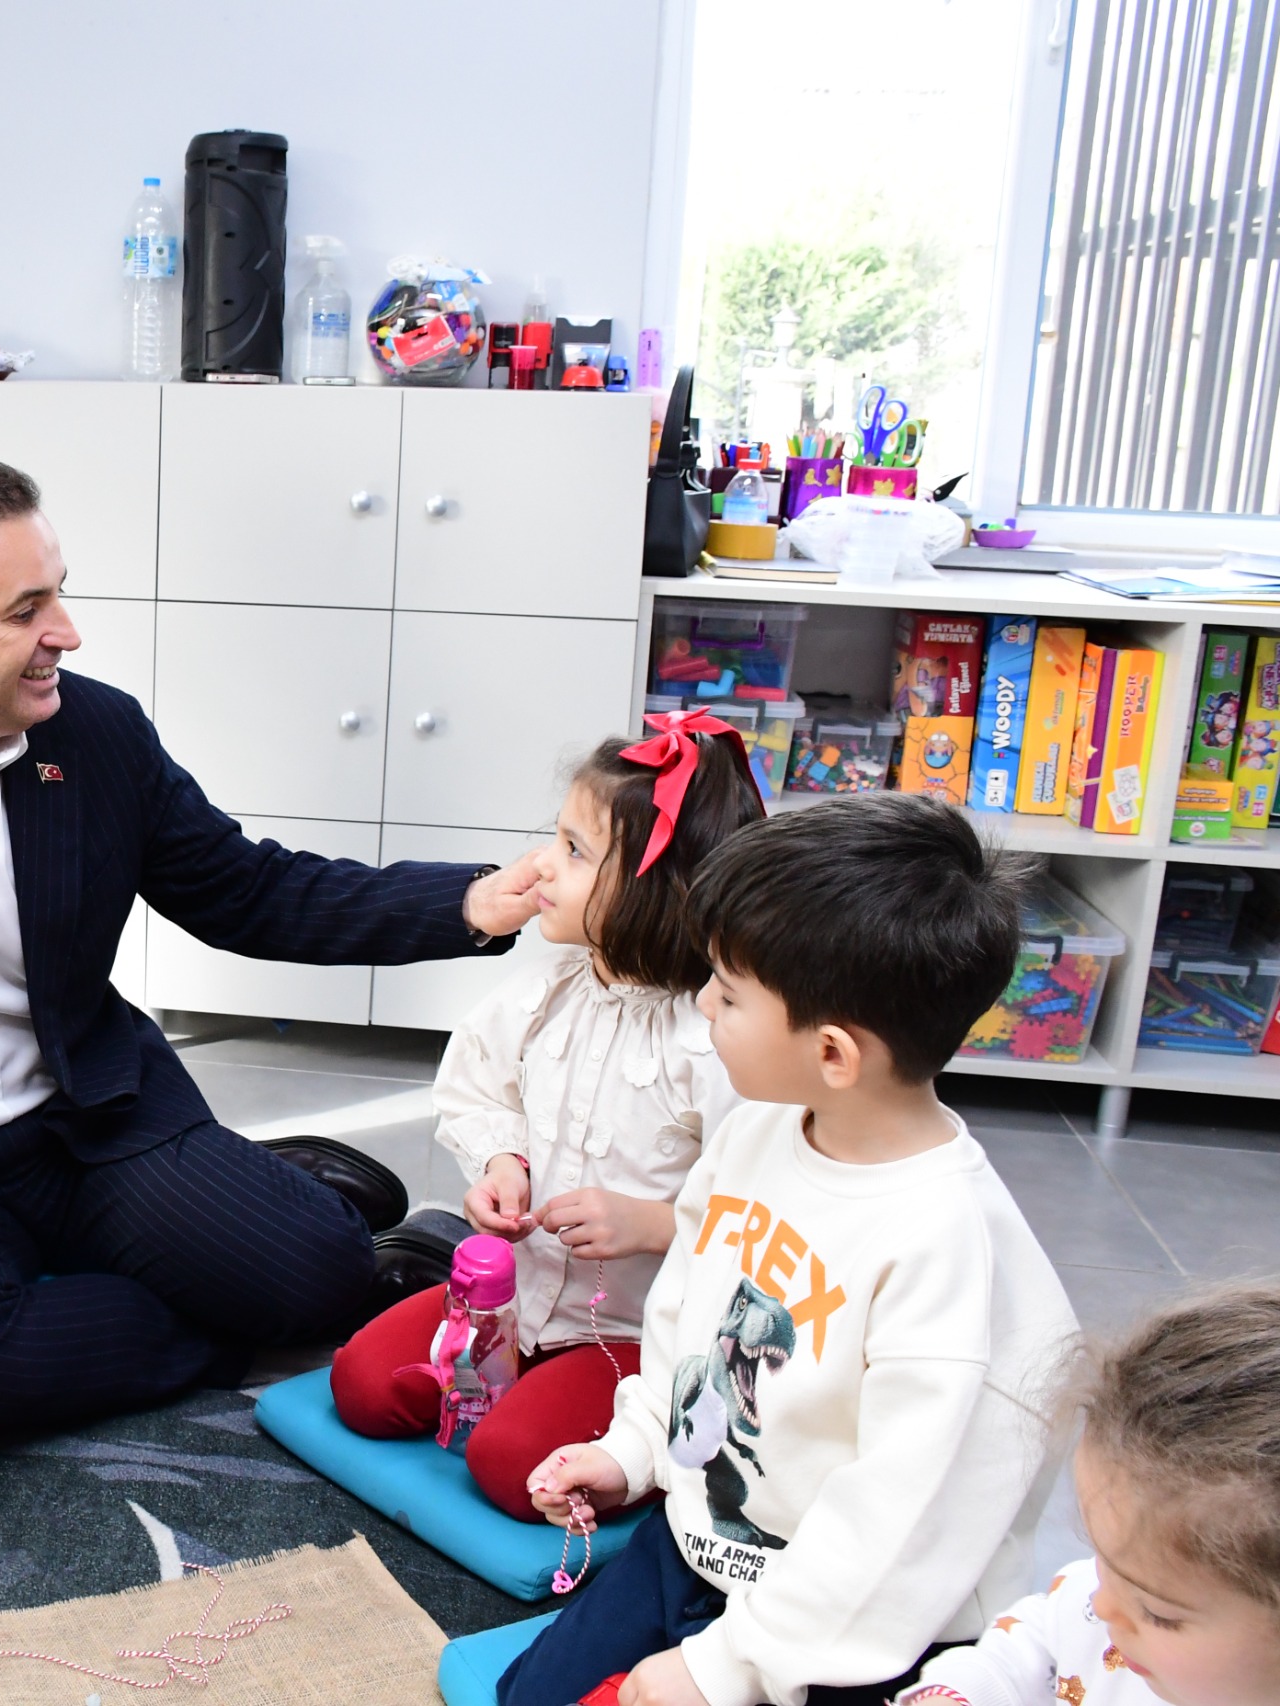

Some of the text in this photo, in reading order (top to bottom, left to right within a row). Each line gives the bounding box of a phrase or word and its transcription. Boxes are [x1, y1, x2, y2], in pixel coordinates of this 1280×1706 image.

[992, 675, 1017, 750] WOODY
[694, 1194, 847, 1365] T-REX
[684, 1532, 718, 1555] TINY
[721, 1545, 767, 1569] ARMS
[696, 1554, 725, 1575] AND
[728, 1563, 765, 1583] CHA
